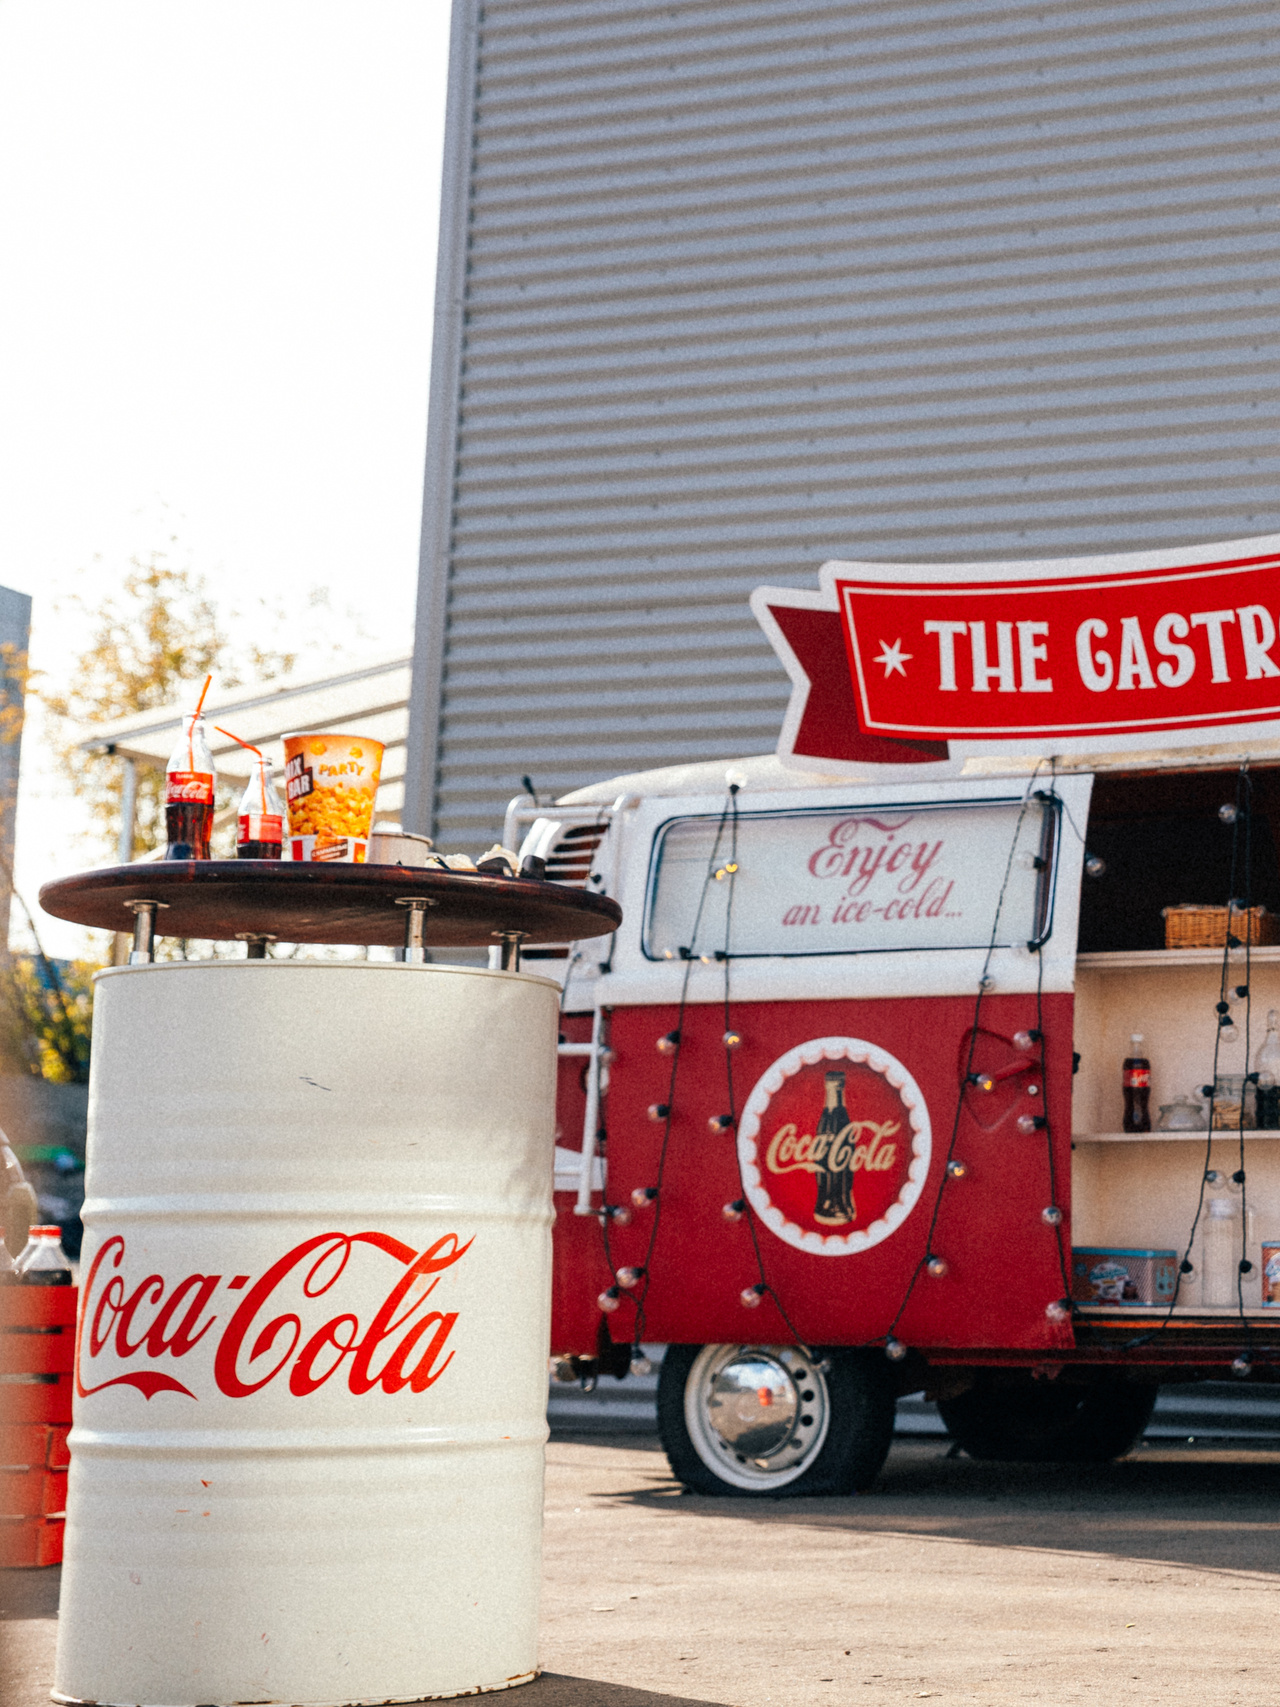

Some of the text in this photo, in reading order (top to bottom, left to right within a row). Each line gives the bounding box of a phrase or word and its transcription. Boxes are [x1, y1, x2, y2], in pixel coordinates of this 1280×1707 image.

[924, 620, 1053, 693] THE
[318, 761, 365, 777] PARTY
[807, 815, 944, 897] Enjoy
[782, 903, 821, 926] an
[766, 1120, 901, 1174] Coca-Cola
[76, 1231, 477, 1402] Coca-Cola
